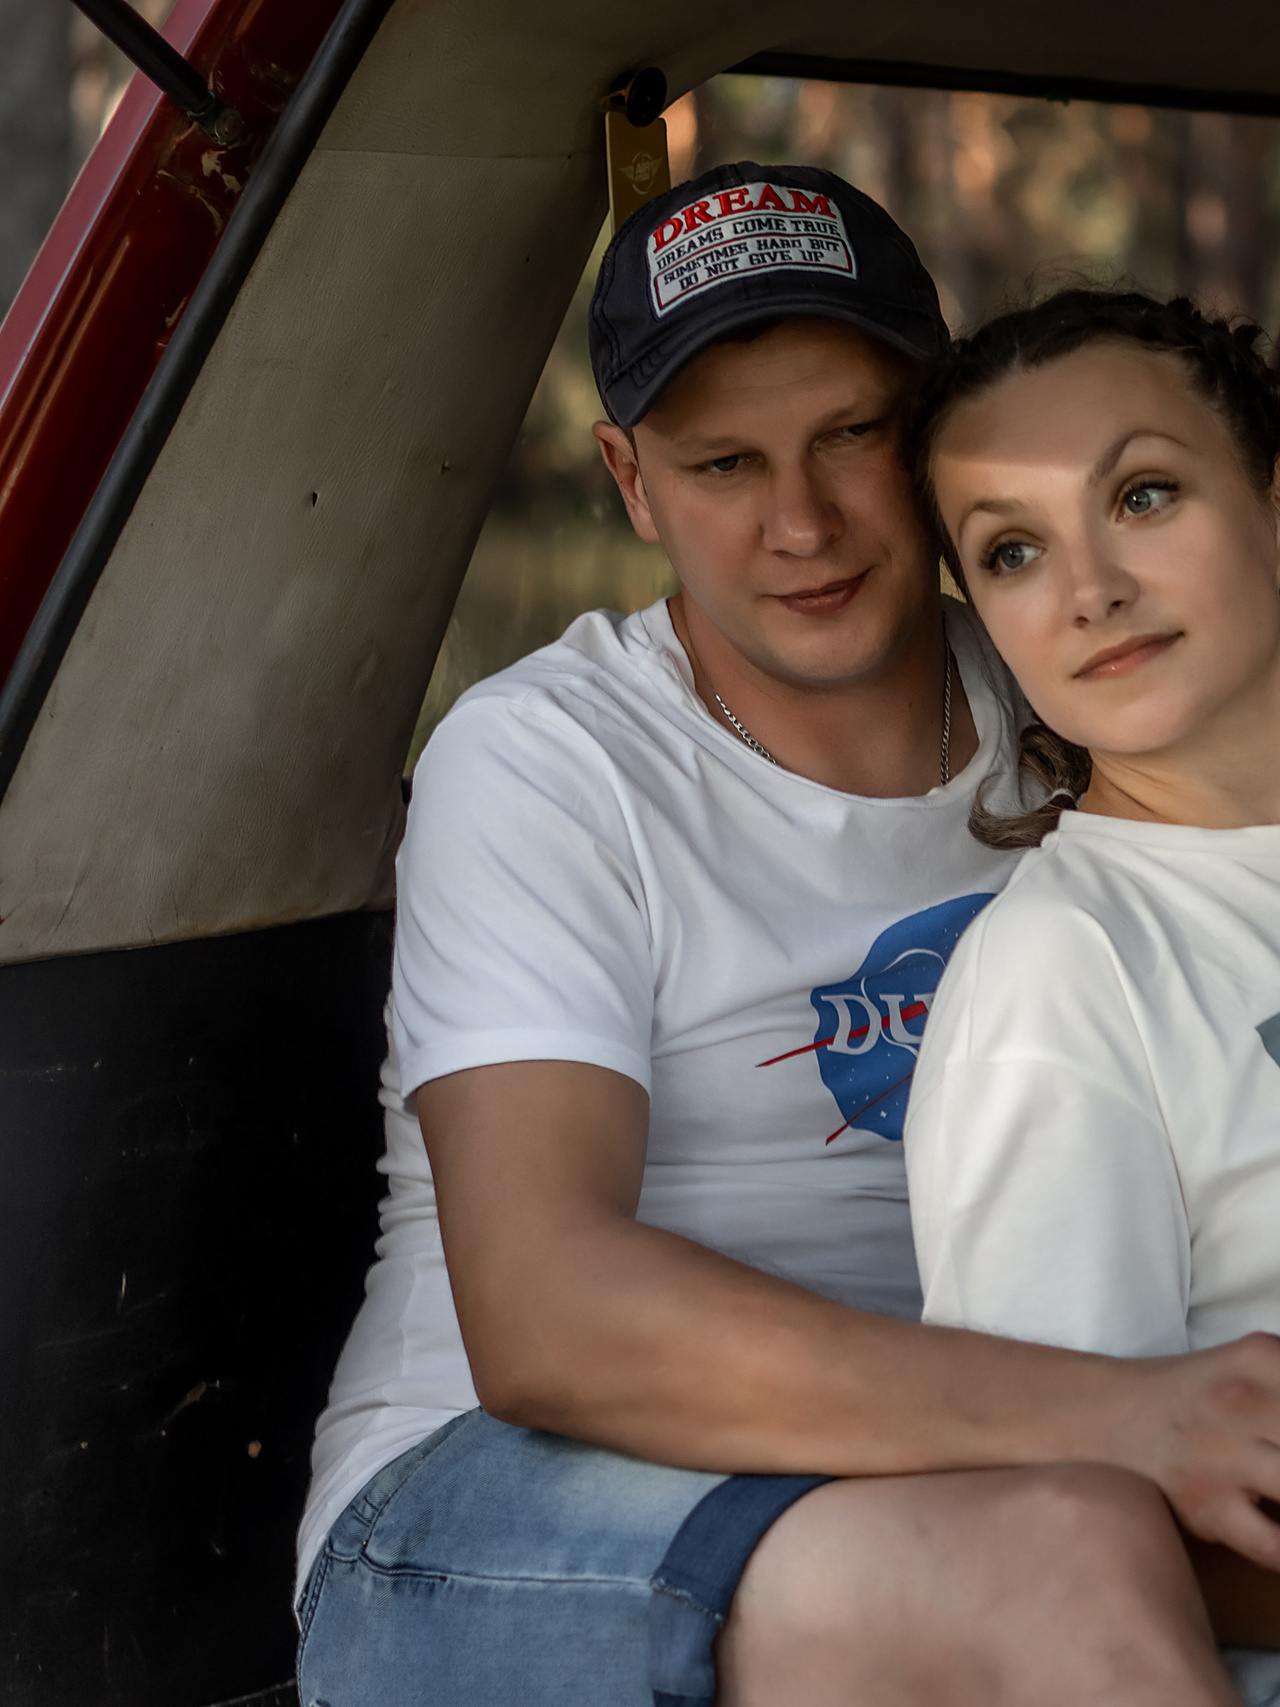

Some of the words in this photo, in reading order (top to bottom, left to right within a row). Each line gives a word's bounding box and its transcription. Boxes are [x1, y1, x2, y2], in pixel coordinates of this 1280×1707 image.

[653, 184, 838, 254] DREAM
[656, 227, 724, 270] DREAMS
[732, 217, 788, 235] COME
[791, 218, 842, 238] TRUE
[663, 242, 749, 286] SOMETIMES
[757, 238, 803, 251] HARD
[808, 238, 841, 252] BUT
[679, 274, 699, 292] DO
[706, 257, 741, 277] NOT
[749, 250, 793, 266] GIVE
[799, 250, 825, 263] UP
